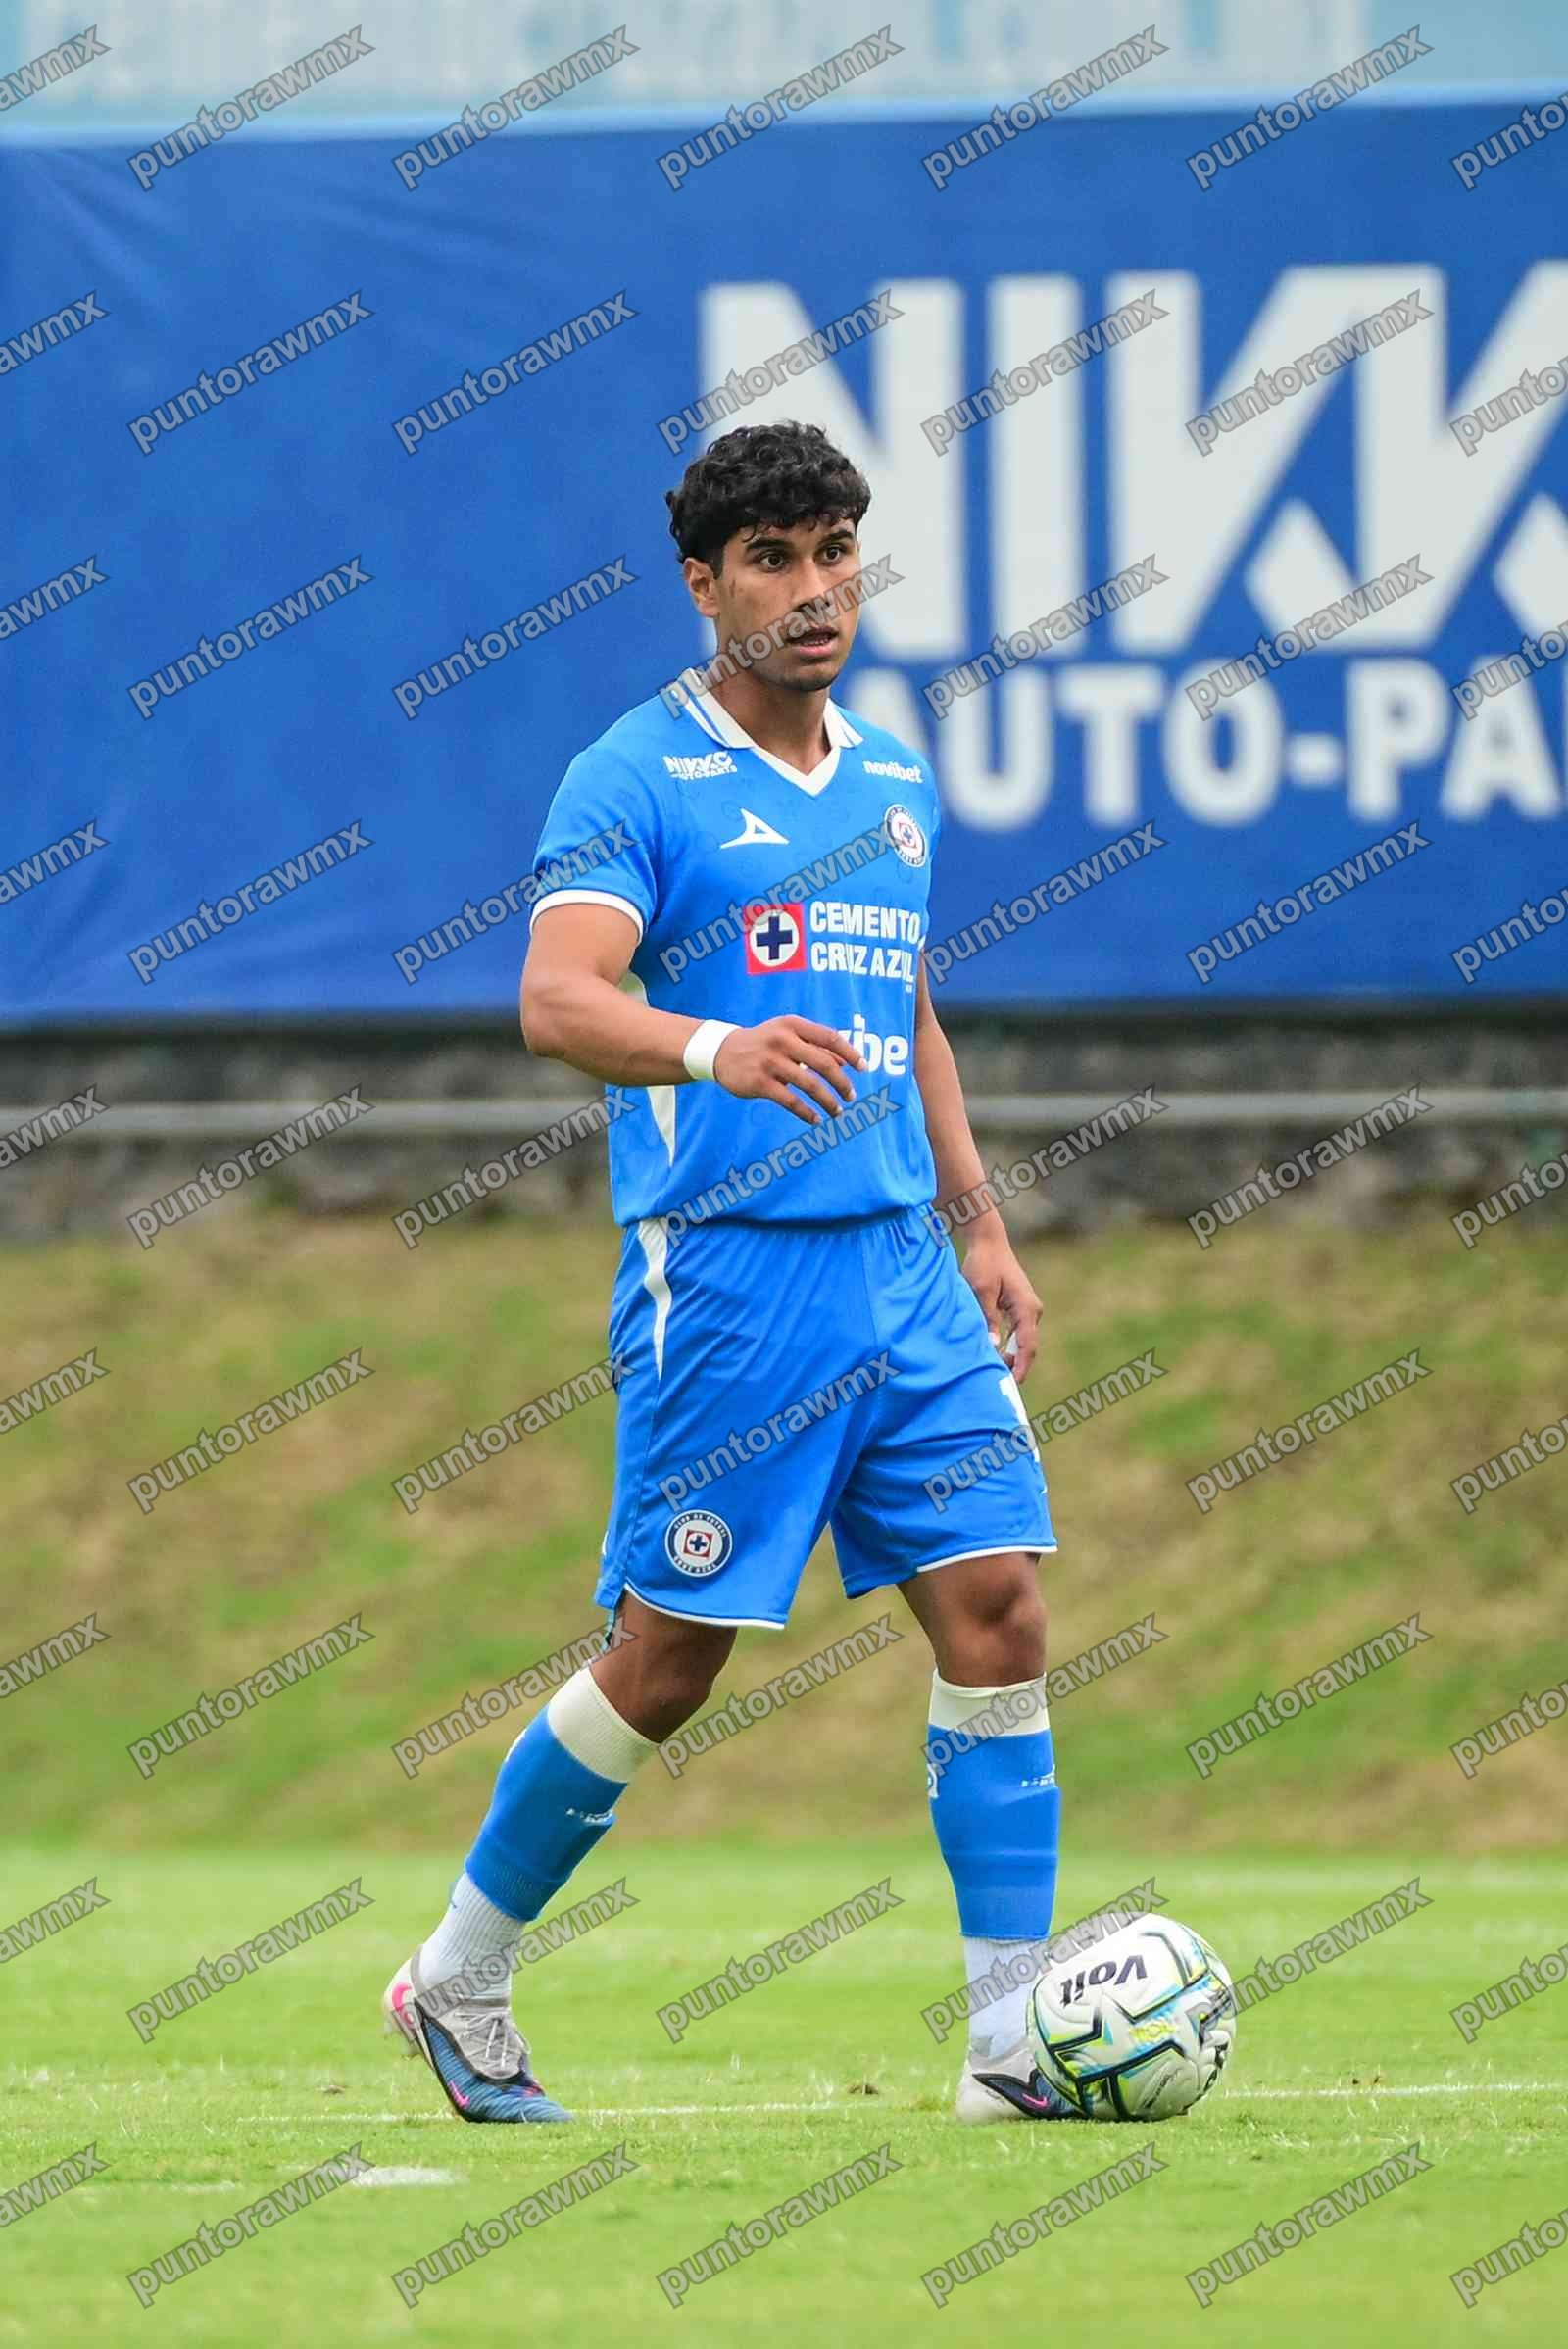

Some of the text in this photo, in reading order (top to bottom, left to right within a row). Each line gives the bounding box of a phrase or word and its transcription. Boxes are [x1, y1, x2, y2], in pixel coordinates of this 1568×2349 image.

[844, 655, 1568, 833] UTO-PA
[862, 760, 923, 783] novibet
[809, 900, 920, 944] CEMENTO
[838, 1013, 909, 1075] ibe
[1057, 1954, 1148, 2008] Voit
